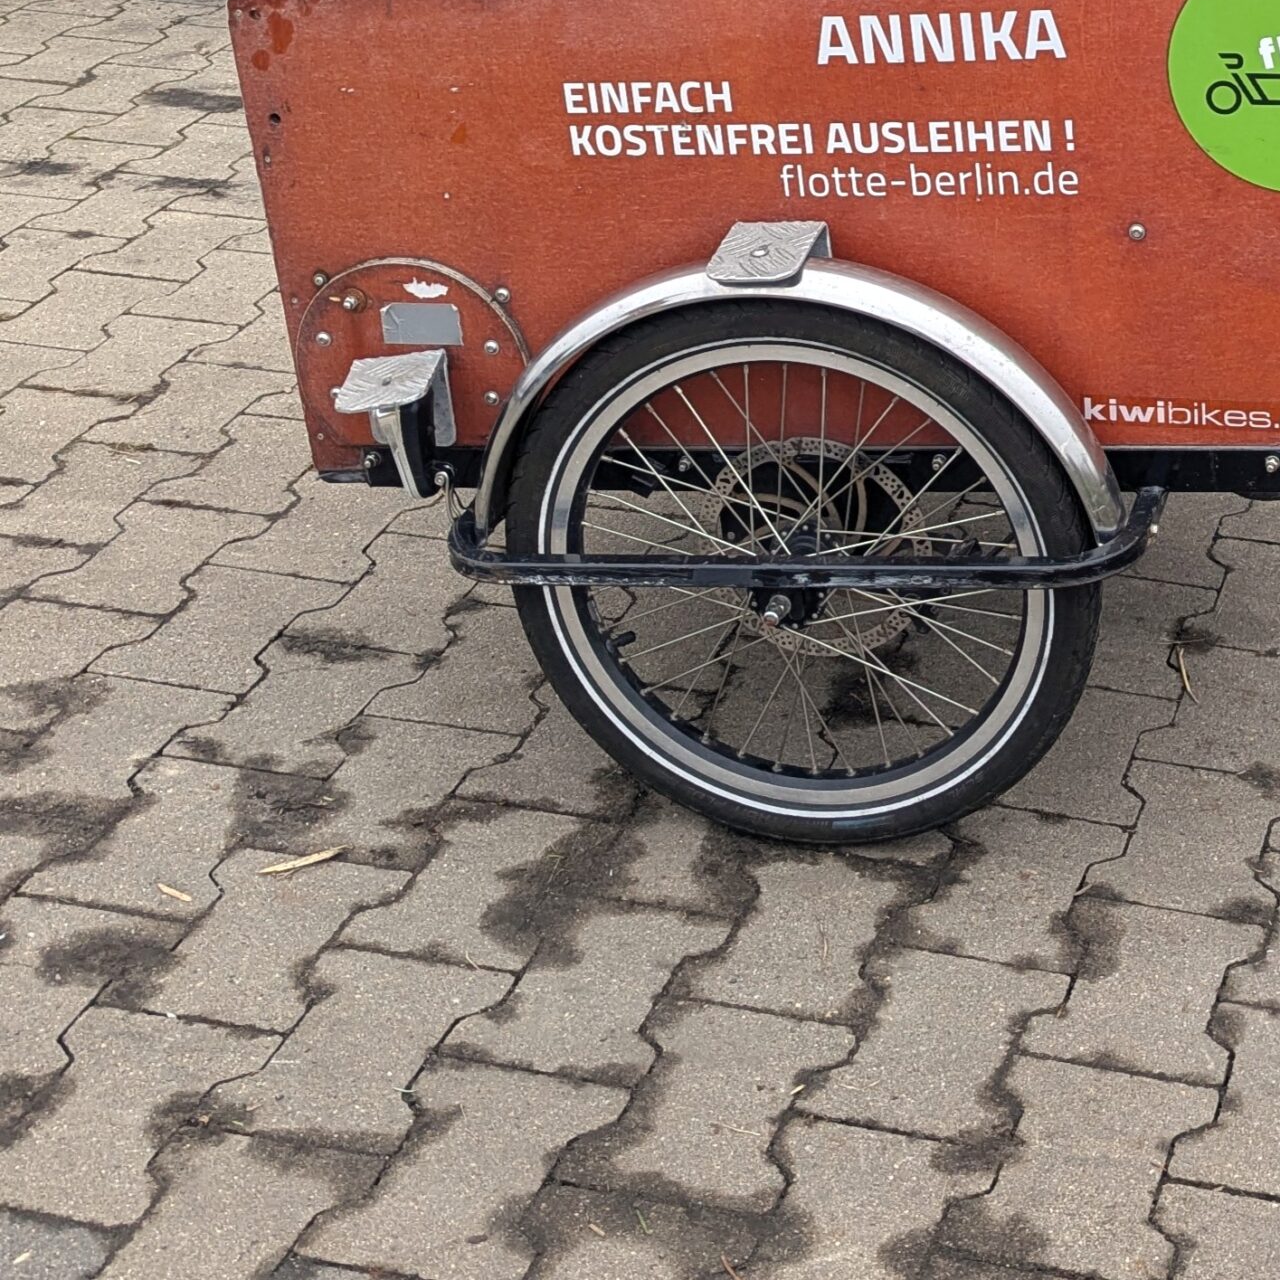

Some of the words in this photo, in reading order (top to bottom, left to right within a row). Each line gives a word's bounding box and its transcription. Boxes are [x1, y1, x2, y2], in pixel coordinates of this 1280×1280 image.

[817, 9, 1067, 65] ANNIKA
[562, 80, 733, 115] EINFACH
[569, 122, 814, 157] KOSTENFREI
[826, 119, 1052, 154] AUSLEIHEN
[1064, 119, 1076, 152] !
[780, 161, 1079, 198] flotte-berlin.de
